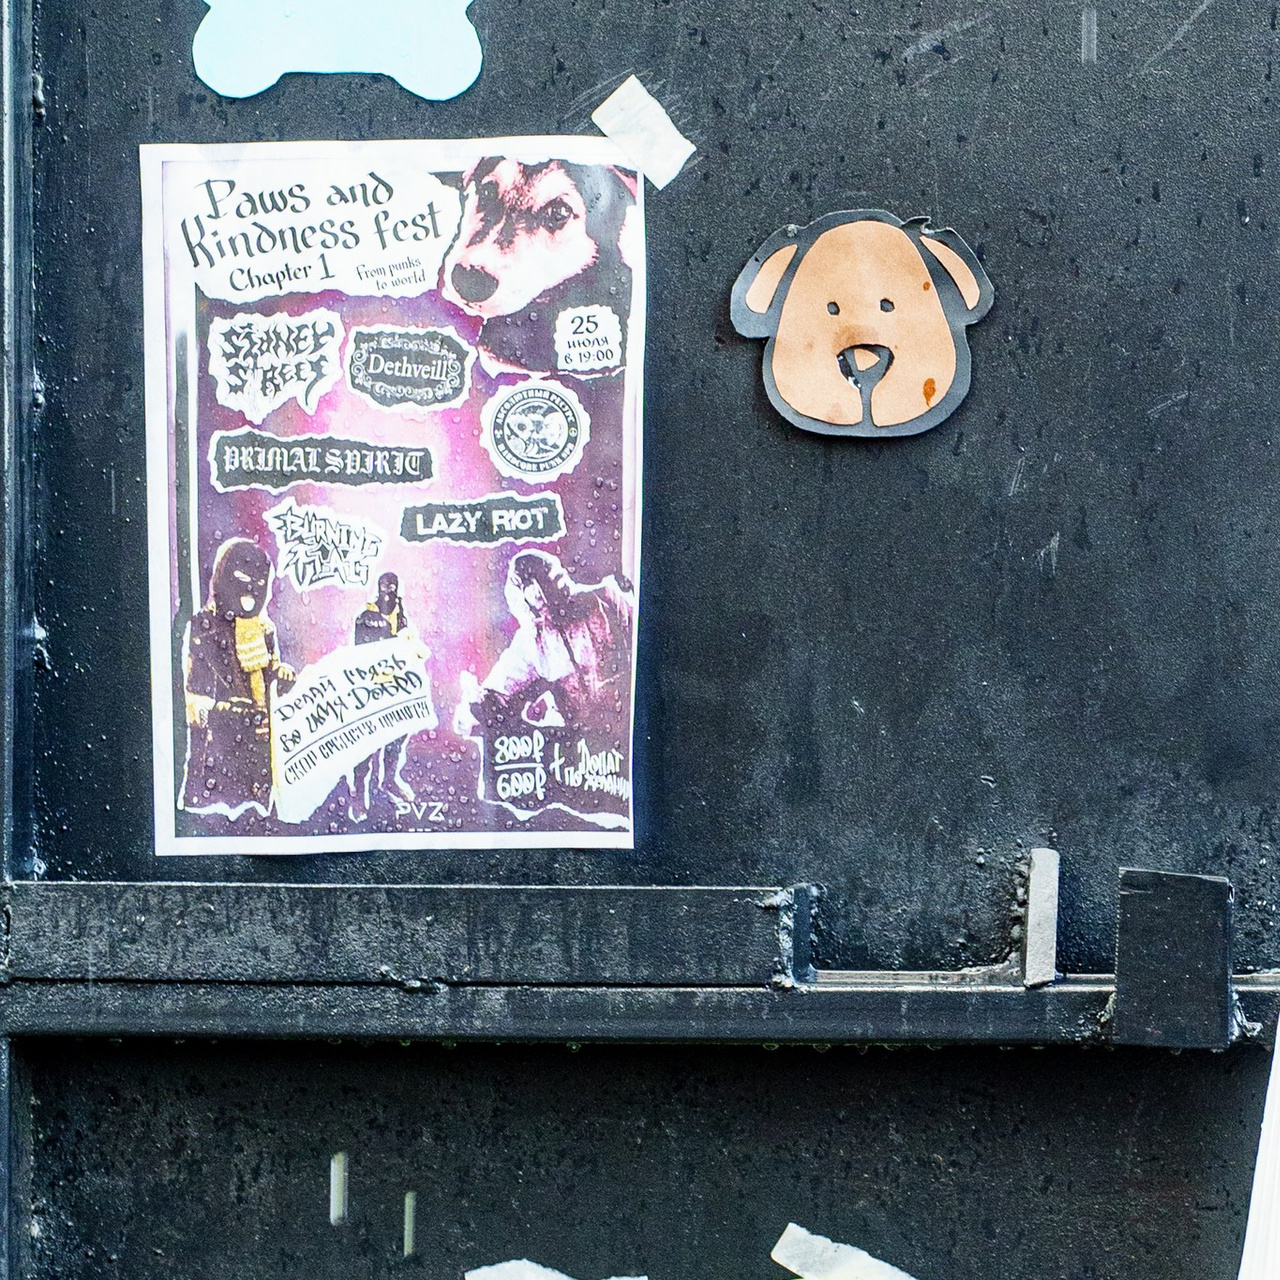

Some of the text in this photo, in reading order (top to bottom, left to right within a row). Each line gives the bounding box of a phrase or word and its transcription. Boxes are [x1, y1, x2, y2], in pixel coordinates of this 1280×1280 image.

[194, 171, 394, 220] Paws and
[180, 215, 360, 268] Kindness
[229, 253, 336, 291] Chapter 1
[356, 256, 422, 282] From punks
[375, 270, 426, 291] to world
[571, 314, 598, 335] 25
[564, 348, 614, 364] в 19:00
[567, 336, 609, 349] июля
[223, 445, 425, 476] PRIMAL SPIRIT
[416, 506, 549, 535] LAZY RIOT
